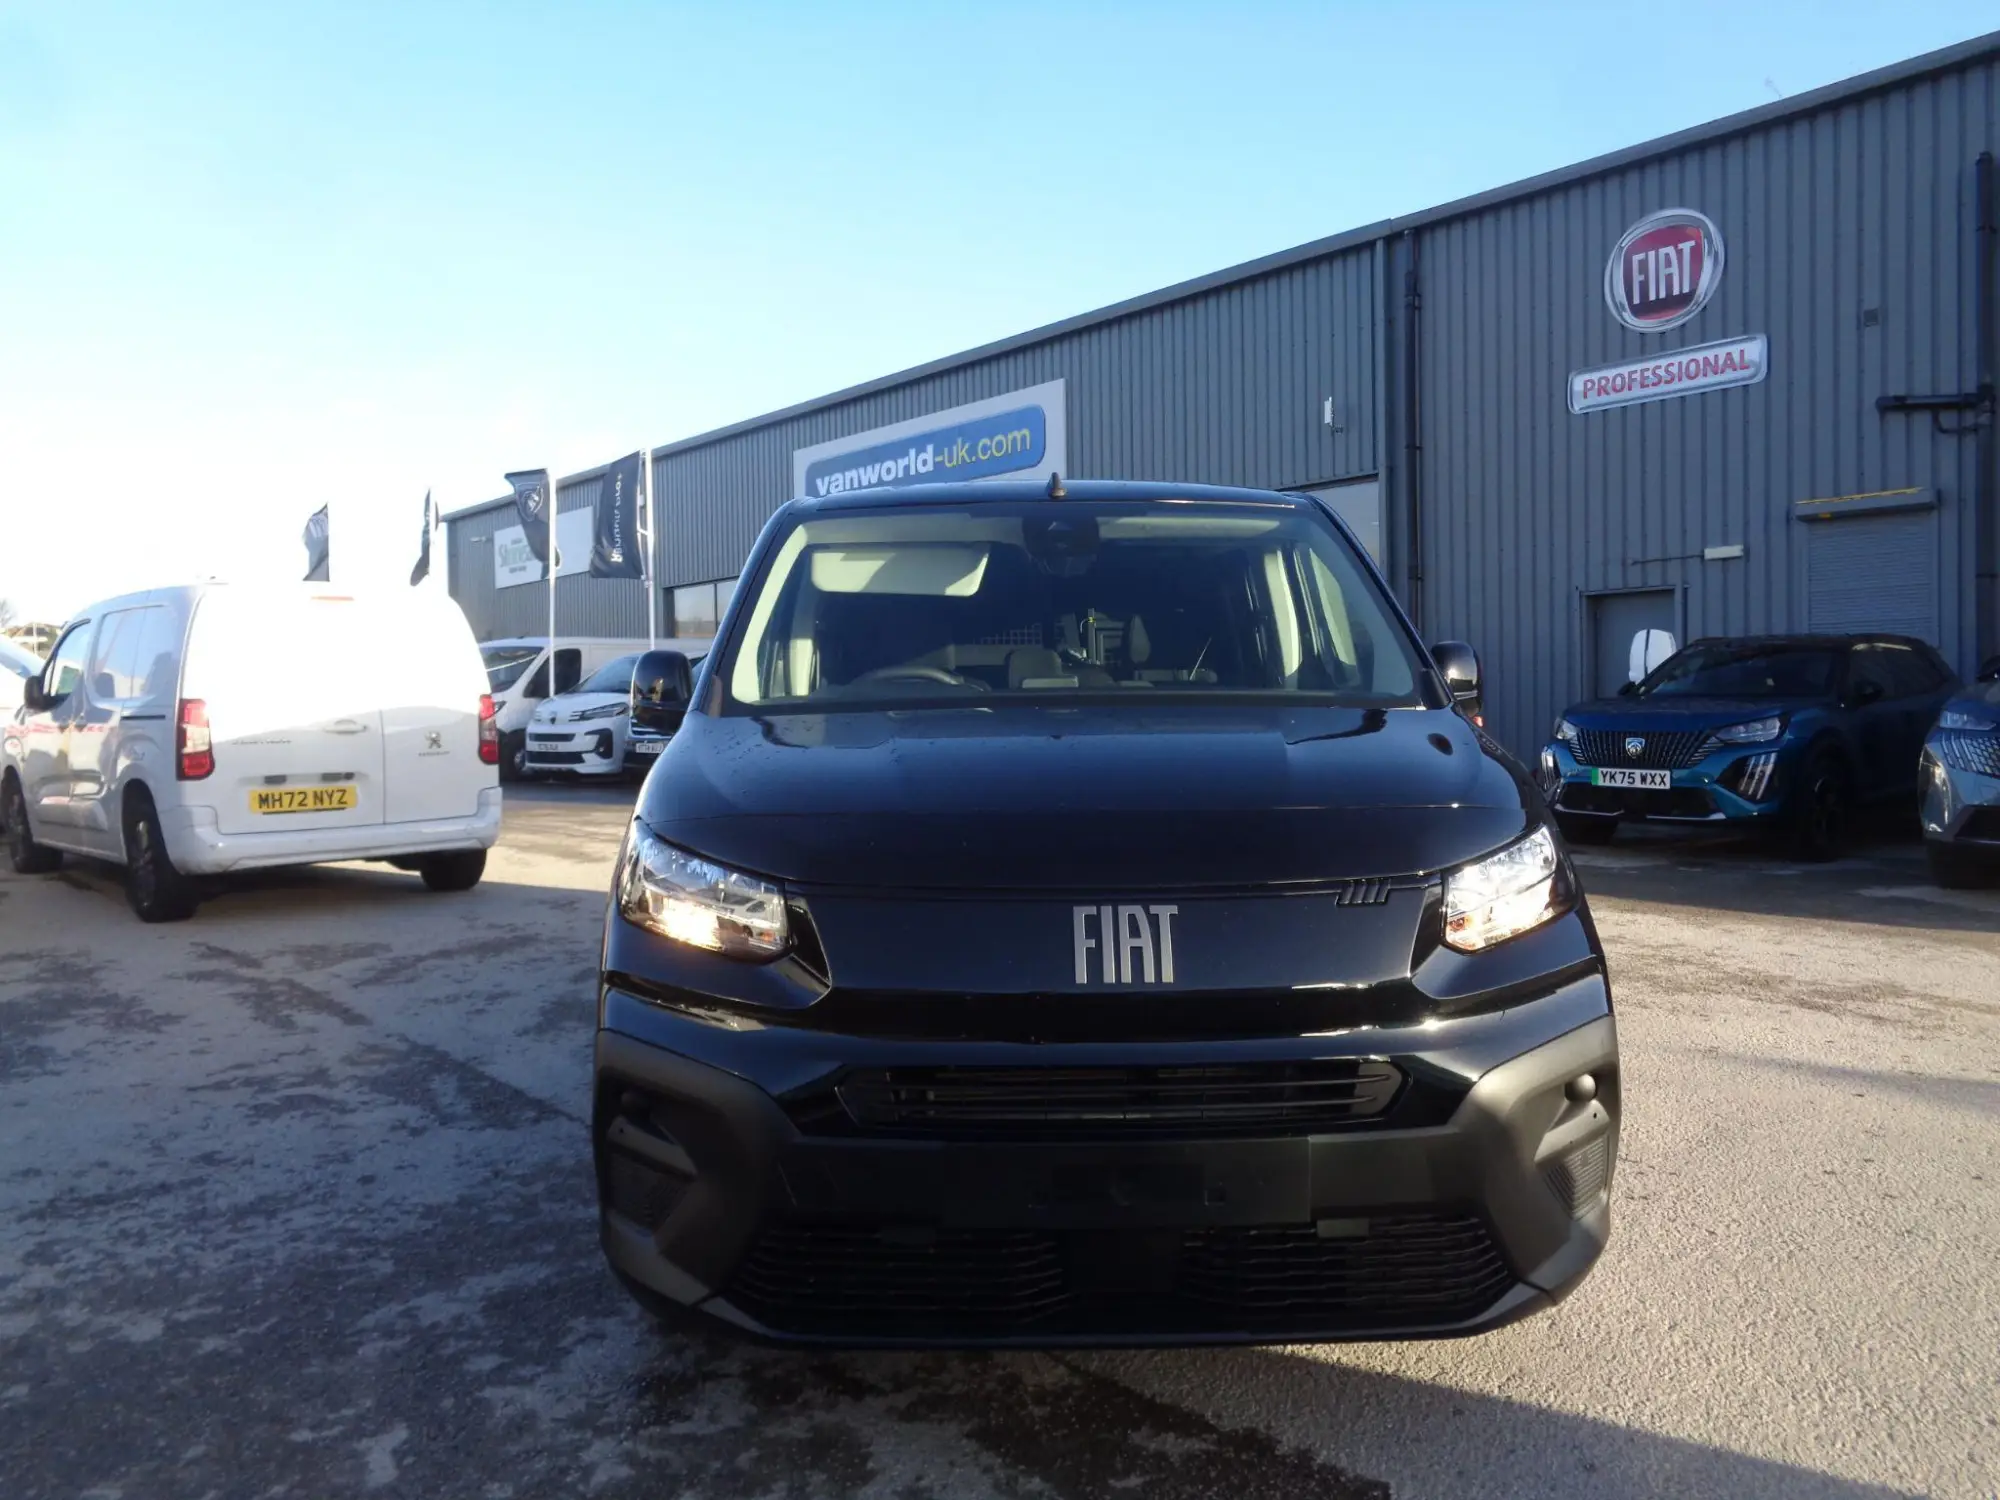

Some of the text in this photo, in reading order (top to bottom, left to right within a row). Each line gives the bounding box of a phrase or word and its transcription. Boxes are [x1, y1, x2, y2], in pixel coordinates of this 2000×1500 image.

[1632, 241, 1696, 305] FIAT
[1582, 348, 1751, 400] PROFESSIONAL
[816, 427, 1031, 496] vanworld-uk.com
[258, 789, 348, 809] MH72 NYZ
[1601, 770, 1667, 787] YK75 WXX
[1073, 905, 1178, 984] FIAT
